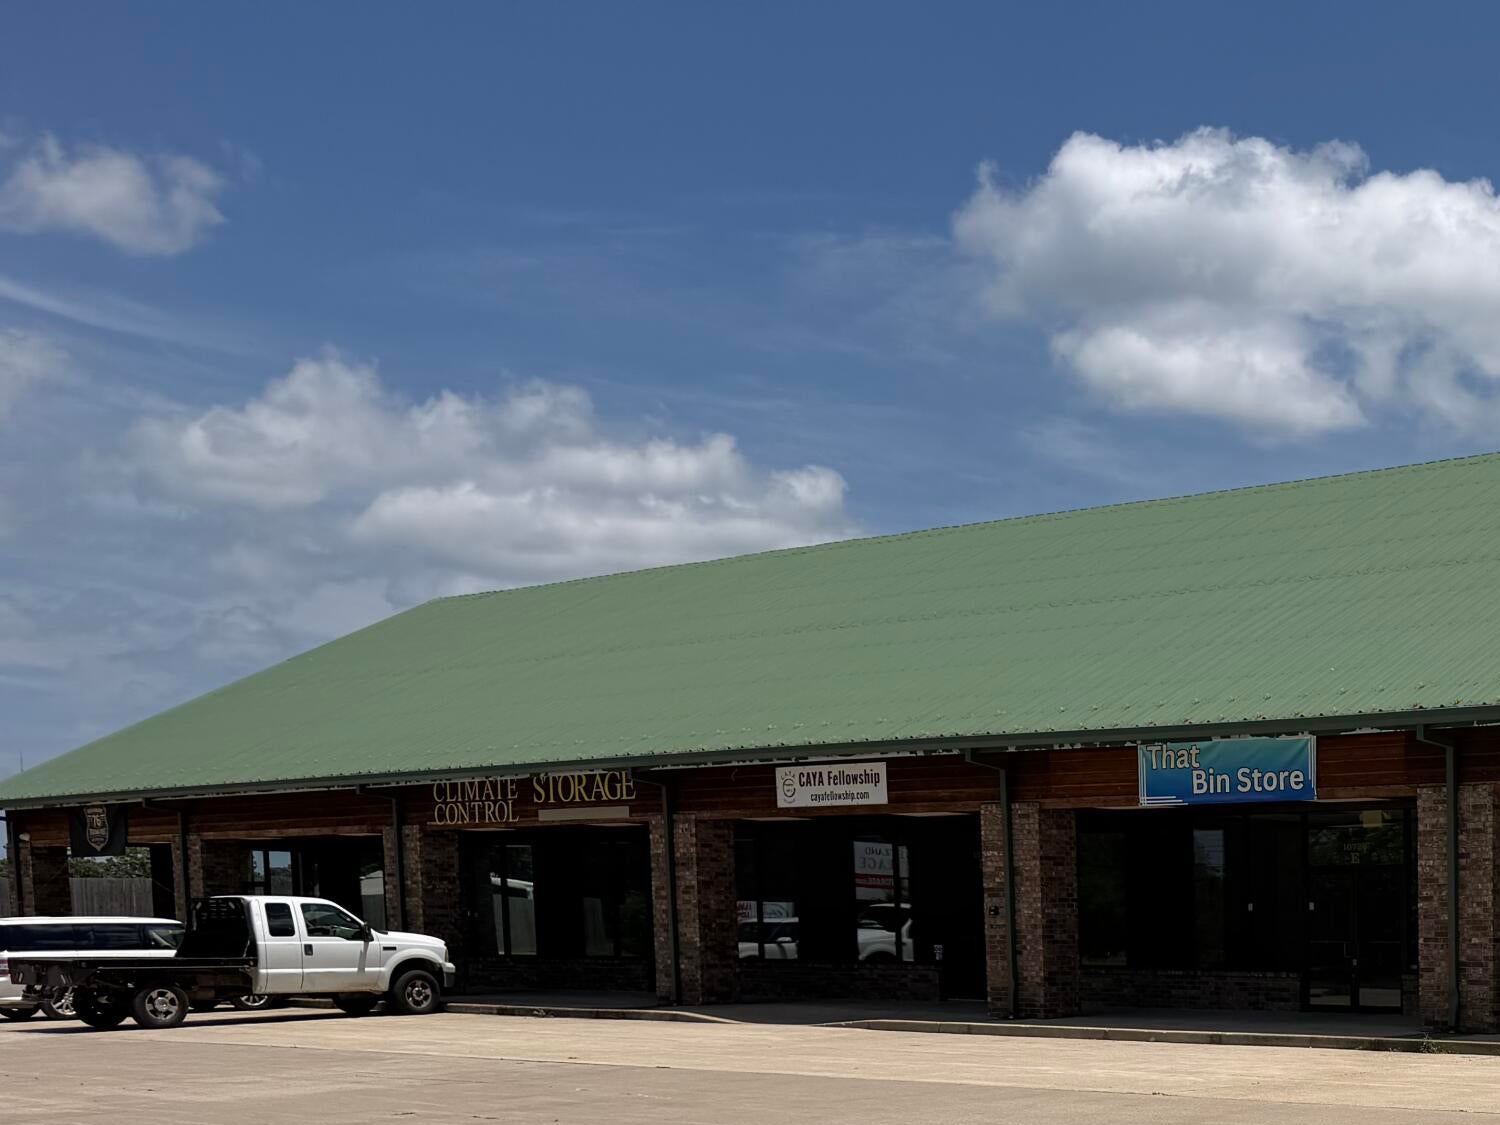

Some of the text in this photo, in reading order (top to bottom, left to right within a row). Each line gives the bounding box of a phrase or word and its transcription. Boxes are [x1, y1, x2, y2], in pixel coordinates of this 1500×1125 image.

[1147, 744, 1200, 770] That
[433, 777, 519, 802] CLIMATE
[533, 771, 636, 804] STORAGE
[798, 769, 880, 787] CAYA Fellowship
[1192, 767, 1304, 794] Bin Store
[810, 790, 870, 803] cayafellowship.com
[434, 800, 520, 825] CONTROL
